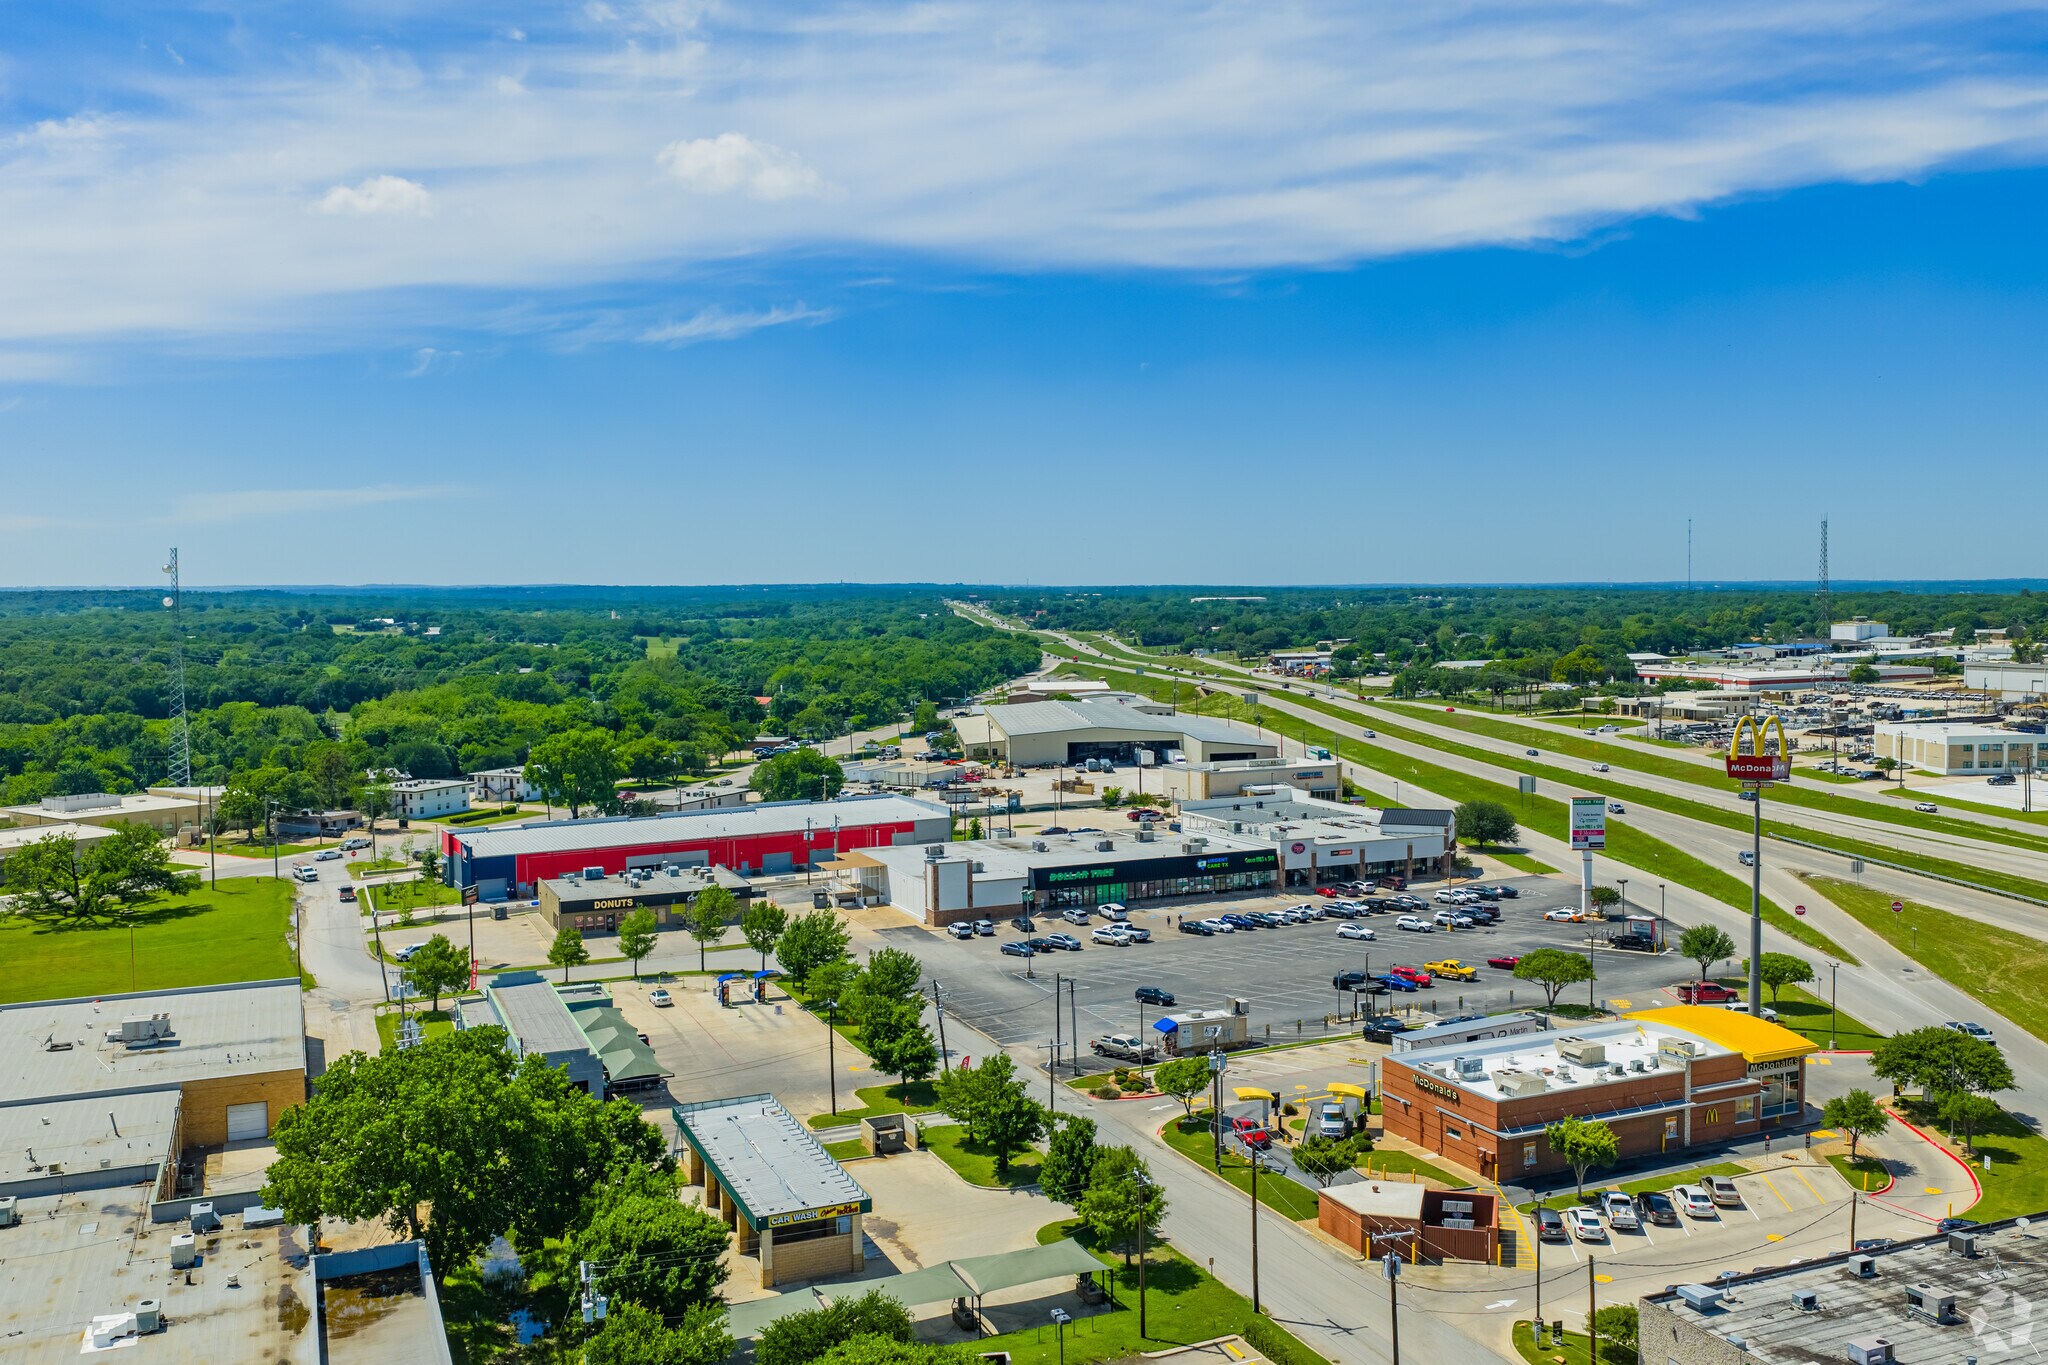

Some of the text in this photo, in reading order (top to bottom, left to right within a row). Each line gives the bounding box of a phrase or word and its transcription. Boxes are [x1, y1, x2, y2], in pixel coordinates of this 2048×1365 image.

[1050, 868, 1114, 881] DOLLAR TREE
[594, 898, 634, 910] DONUTS
[1510, 1026, 1528, 1036] Martin
[1750, 1056, 1800, 1073] McDonald's
[1412, 1073, 1458, 1100] McDonald's
[771, 1206, 836, 1226] CAR WASH Open
